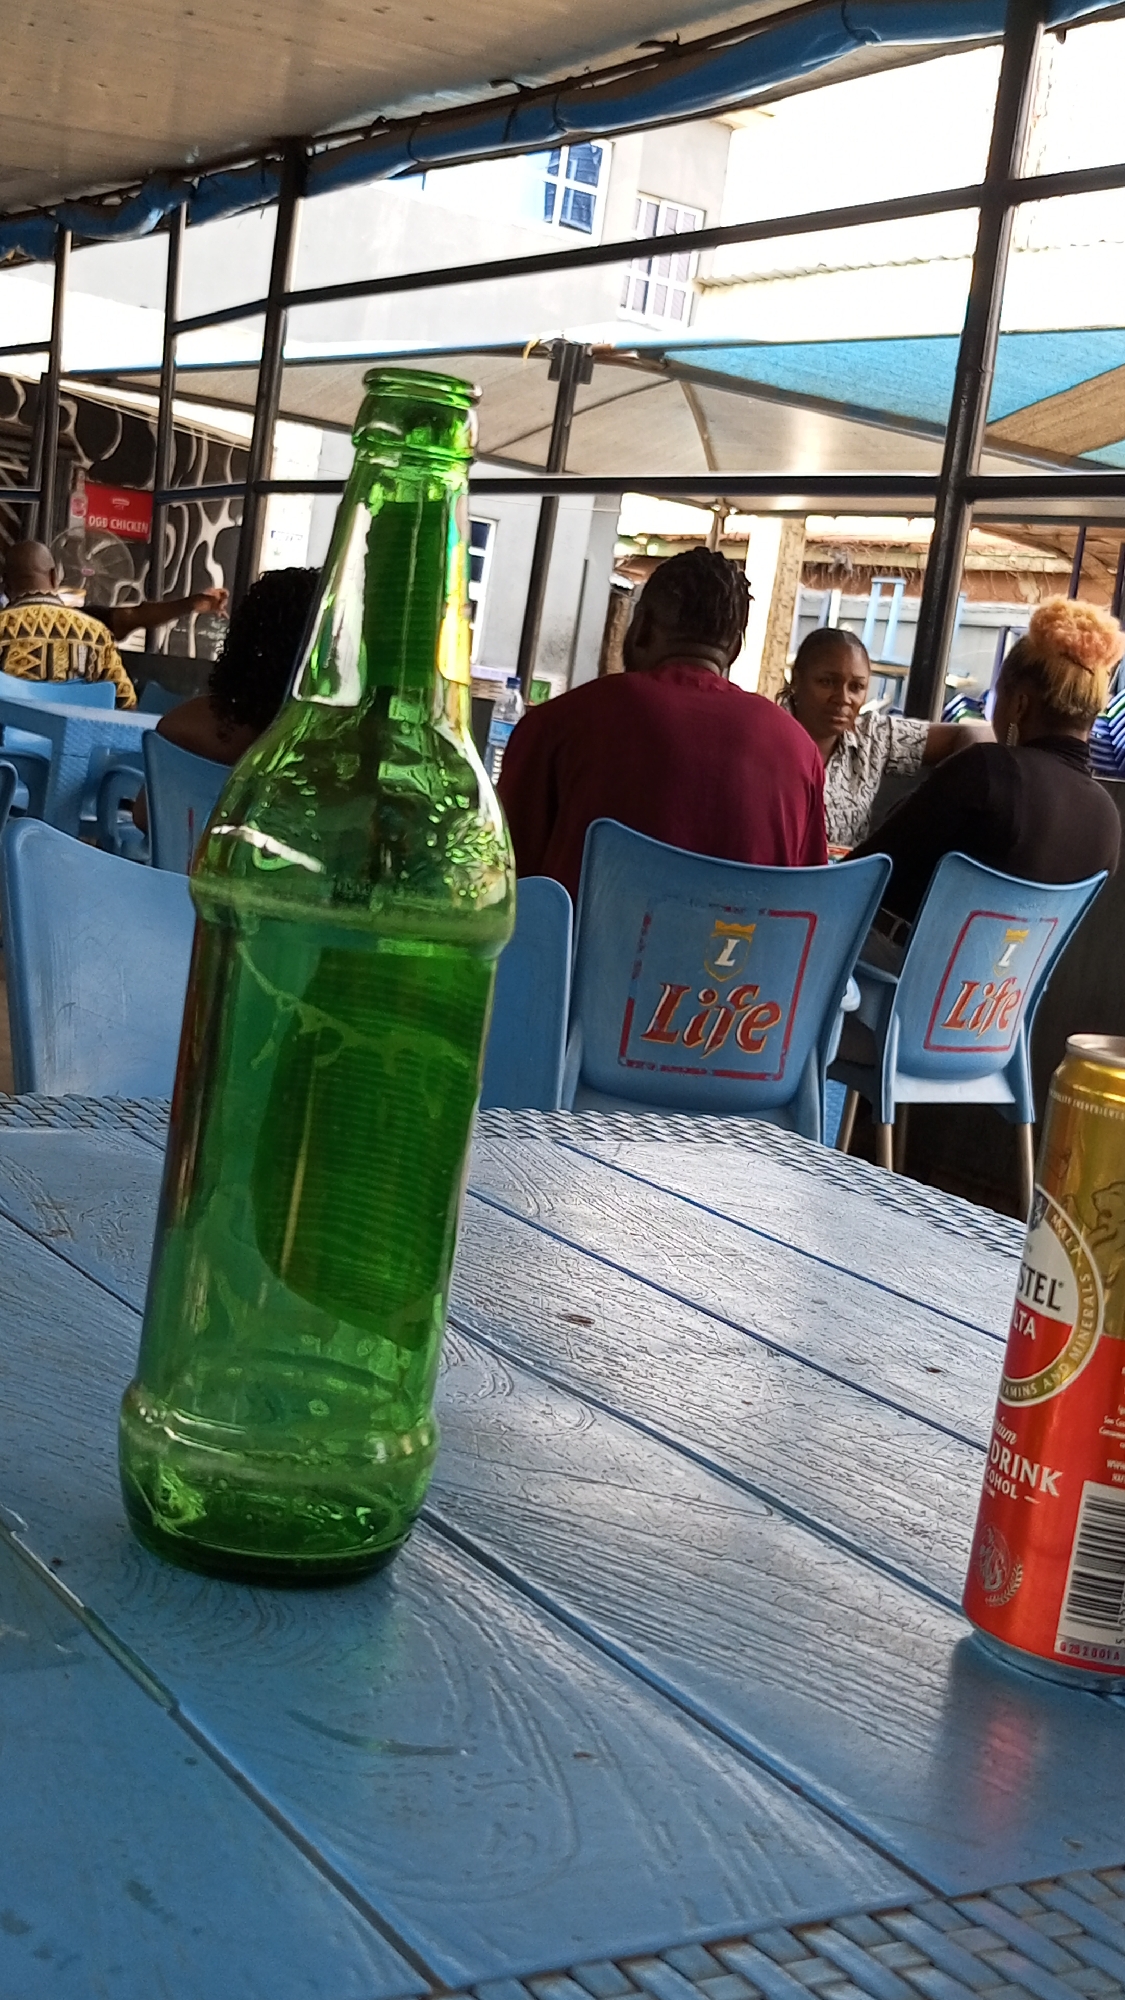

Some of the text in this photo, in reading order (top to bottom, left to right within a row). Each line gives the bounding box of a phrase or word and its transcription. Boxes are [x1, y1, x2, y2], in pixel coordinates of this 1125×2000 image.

[110, 518, 149, 534] CHICKEN
[640, 982, 782, 1060] Life
[941, 977, 1022, 1041] Life
[1068, 1272, 1096, 1362] MINERALS
[990, 1438, 1063, 1498] DRINK
